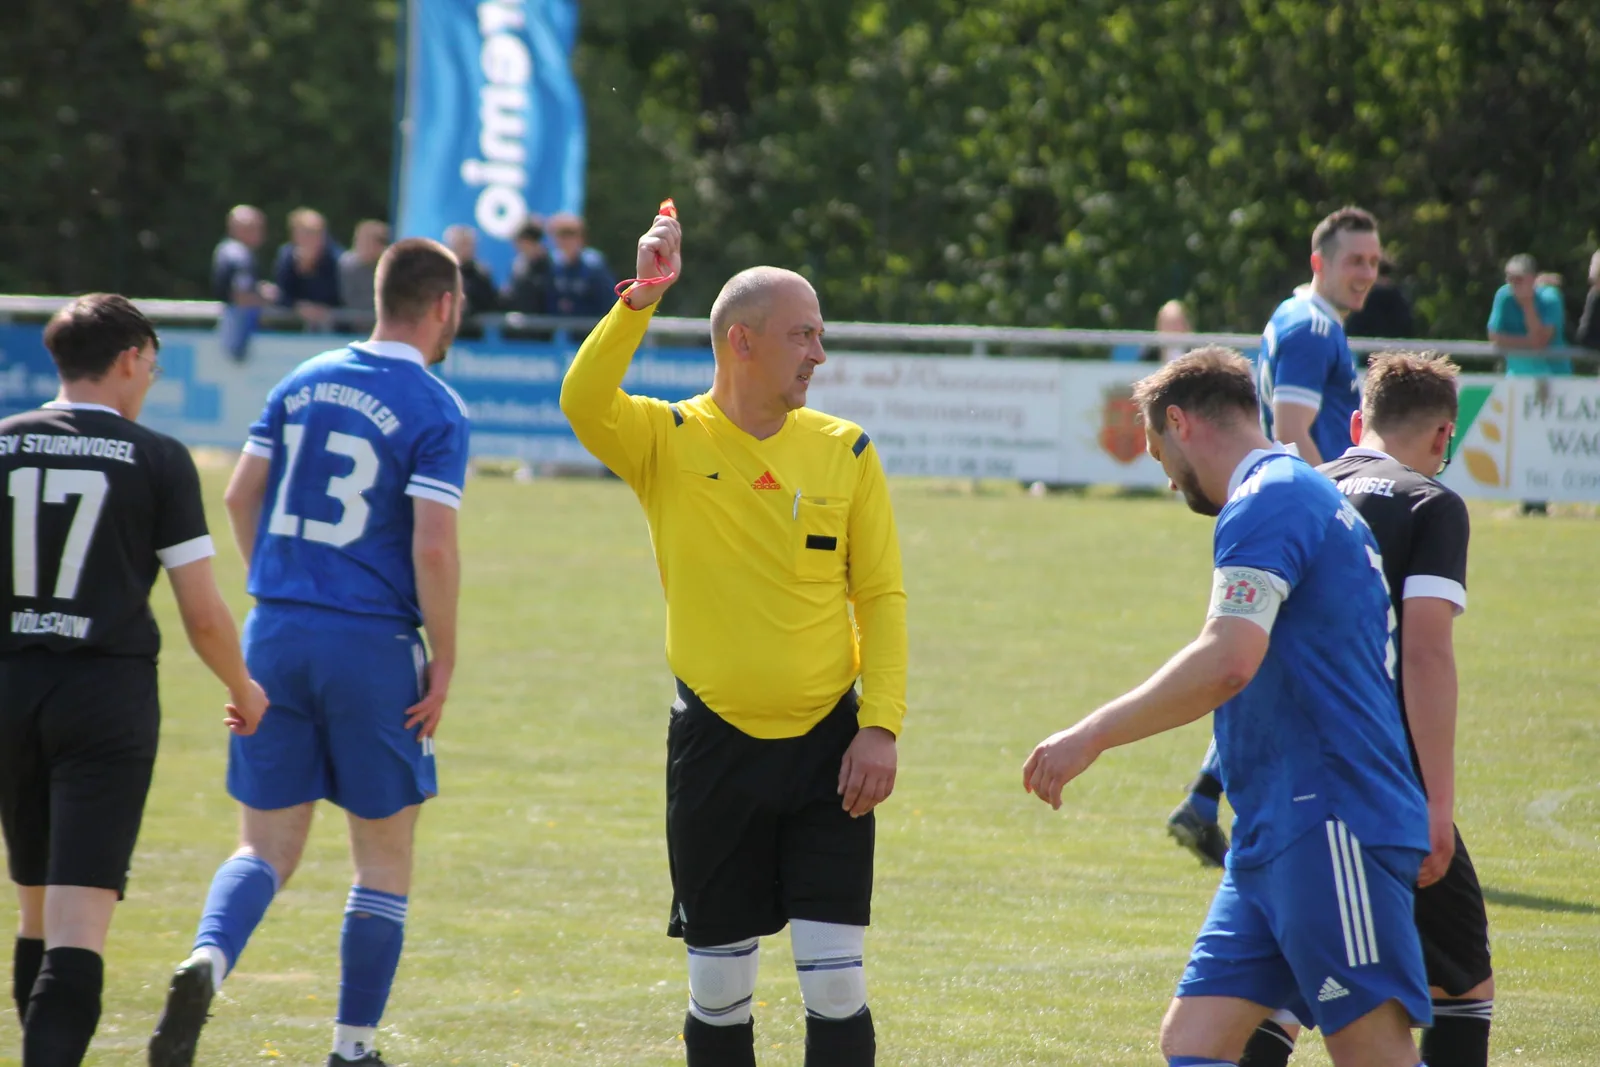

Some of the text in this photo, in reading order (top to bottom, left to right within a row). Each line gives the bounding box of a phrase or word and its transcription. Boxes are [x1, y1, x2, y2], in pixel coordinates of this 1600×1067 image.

[312, 382, 401, 436] NEUKALEN
[21, 433, 138, 465] STURMVOGEL
[268, 423, 380, 548] 13
[8, 466, 109, 600] 17
[10, 607, 92, 639] VÖLSCHOW
[1317, 987, 1351, 1002] adidas
